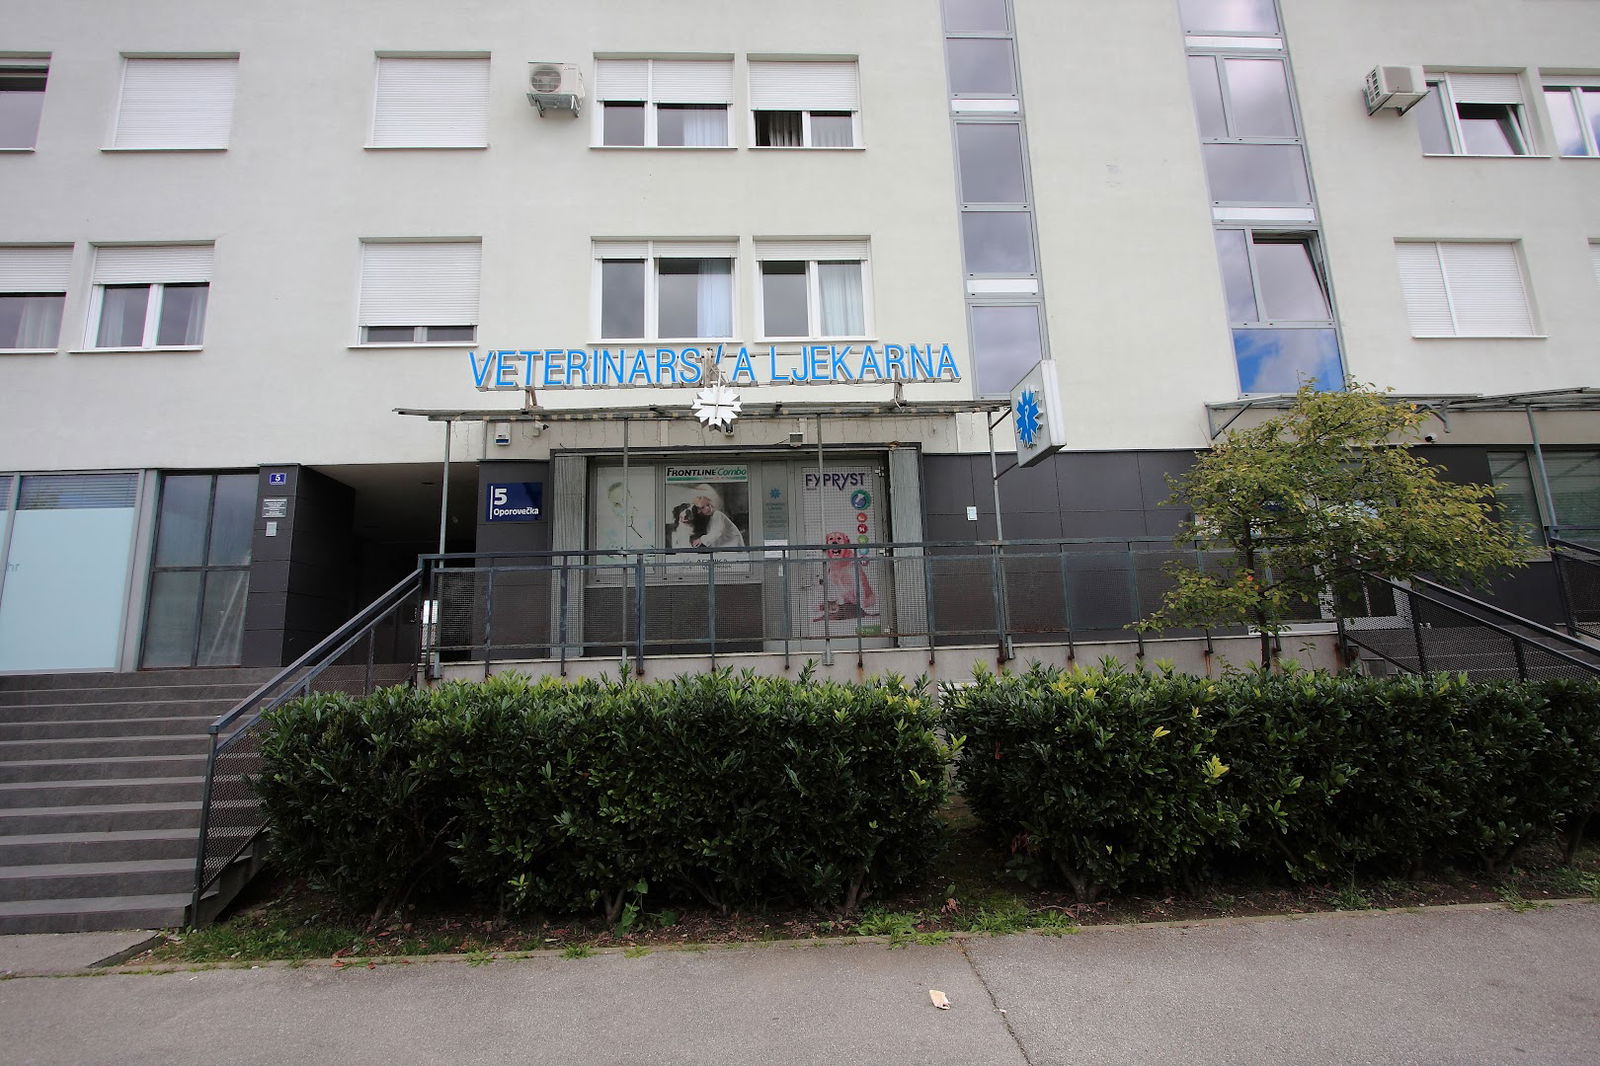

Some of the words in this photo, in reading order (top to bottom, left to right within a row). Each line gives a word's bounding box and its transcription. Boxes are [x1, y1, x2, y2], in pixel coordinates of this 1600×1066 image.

[769, 344, 961, 384] LJEKARNA
[275, 474, 281, 482] 5
[667, 467, 716, 476] FRONTLINE
[717, 466, 747, 476] Combo
[805, 472, 866, 491] FYPRYST
[494, 488, 508, 505] 5
[493, 506, 539, 517] Oporovečka
